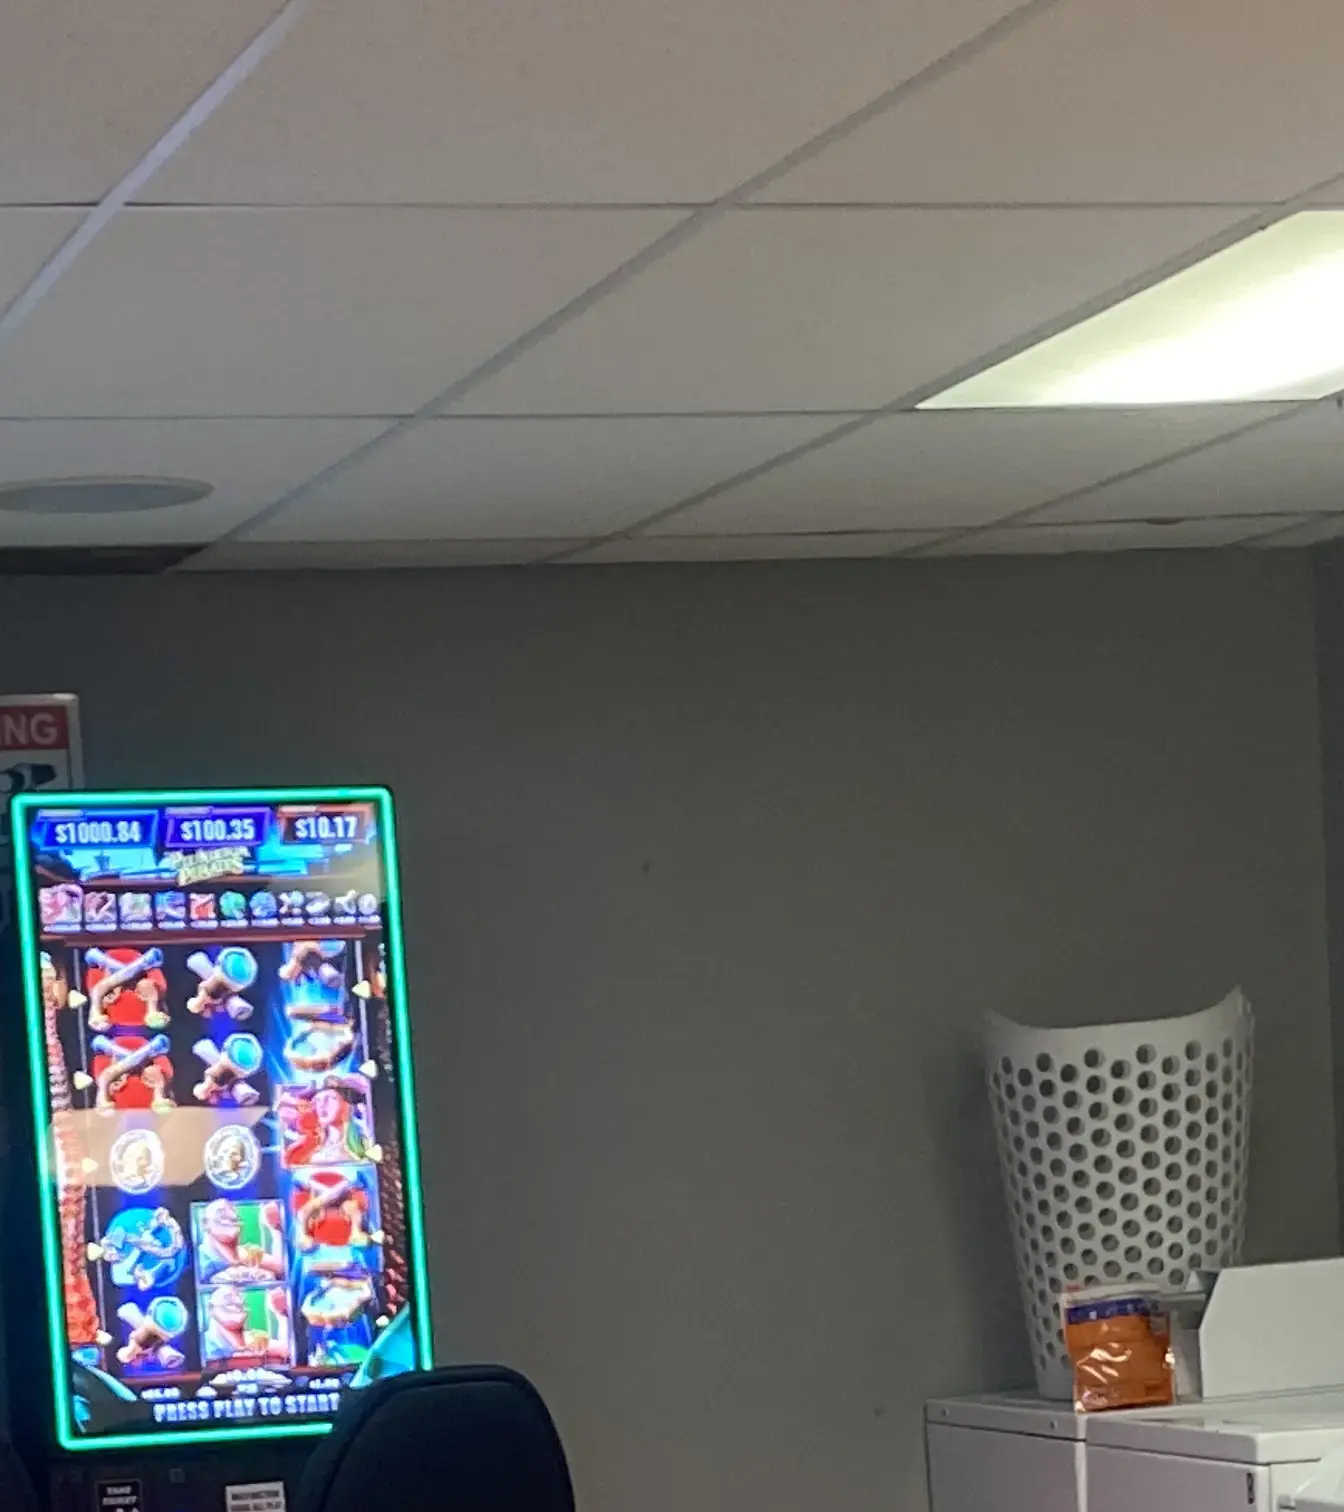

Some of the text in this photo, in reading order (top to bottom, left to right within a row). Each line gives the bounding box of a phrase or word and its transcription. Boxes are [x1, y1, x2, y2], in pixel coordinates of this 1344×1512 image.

[55, 820, 141, 844] $1000.84
[180, 818, 256, 842] $100.35
[295, 815, 357, 839] $10.17
[153, 1392, 340, 1422] PRESS PLAY TO START
